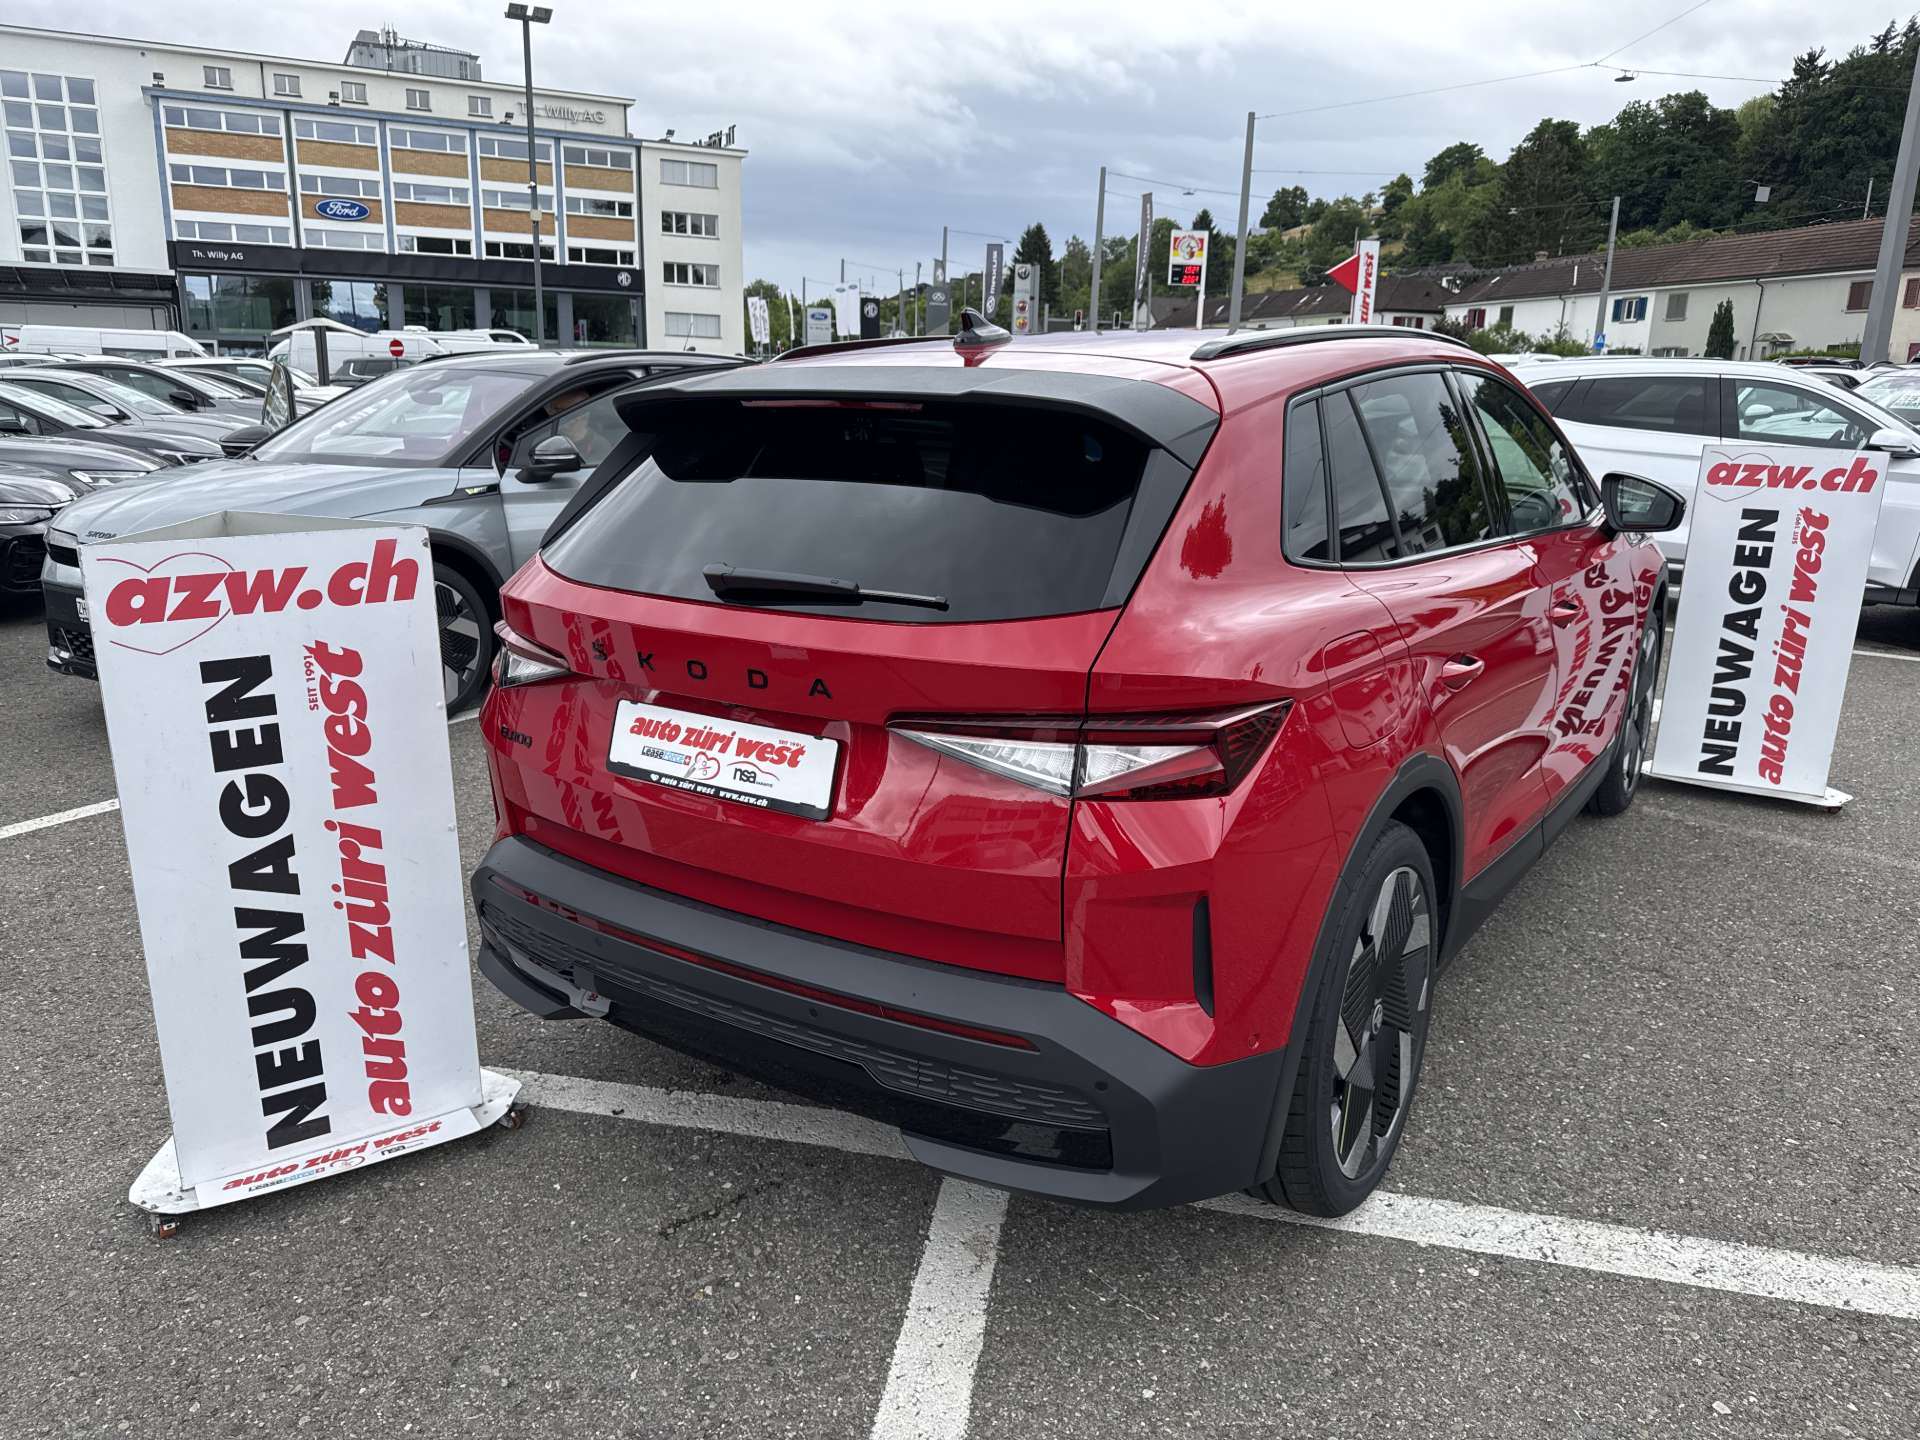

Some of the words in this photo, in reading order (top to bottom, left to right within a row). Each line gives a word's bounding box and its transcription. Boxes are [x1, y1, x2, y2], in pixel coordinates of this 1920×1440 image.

[545, 103, 579, 122] Willy
[583, 108, 606, 124] AG
[326, 201, 359, 217] Ford
[191, 249, 206, 259] Th.
[207, 250, 229, 262] Willy
[230, 251, 244, 261] AG
[617, 271, 632, 288] MG
[863, 301, 879, 319] MG
[1706, 456, 1878, 494] azw.ch
[1788, 506, 1830, 604] west
[1791, 530, 1800, 545] SEIT
[105, 538, 420, 628] azw.ch
[1697, 507, 1780, 778] NEUWAGEN
[1773, 604, 1811, 696] züri
[303, 654, 316, 683] 1991
[307, 687, 319, 712] SEIT
[302, 640, 378, 810] west
[629, 716, 682, 744] auto
[679, 725, 737, 754] züri
[736, 737, 807, 769] west
[1757, 694, 1794, 786] auto
[660, 776, 678, 786] auto
[677, 780, 696, 791] züri
[696, 785, 716, 796] west
[719, 790, 769, 808] www.azw.ch
[733, 764, 758, 785] nsa
[199, 653, 332, 1151] NEUWAGEN
[321, 820, 396, 965] züri
[346, 971, 413, 1117] auto
[221, 1163, 300, 1191] auto
[302, 1140, 369, 1170] züri
[372, 1119, 443, 1149] west
